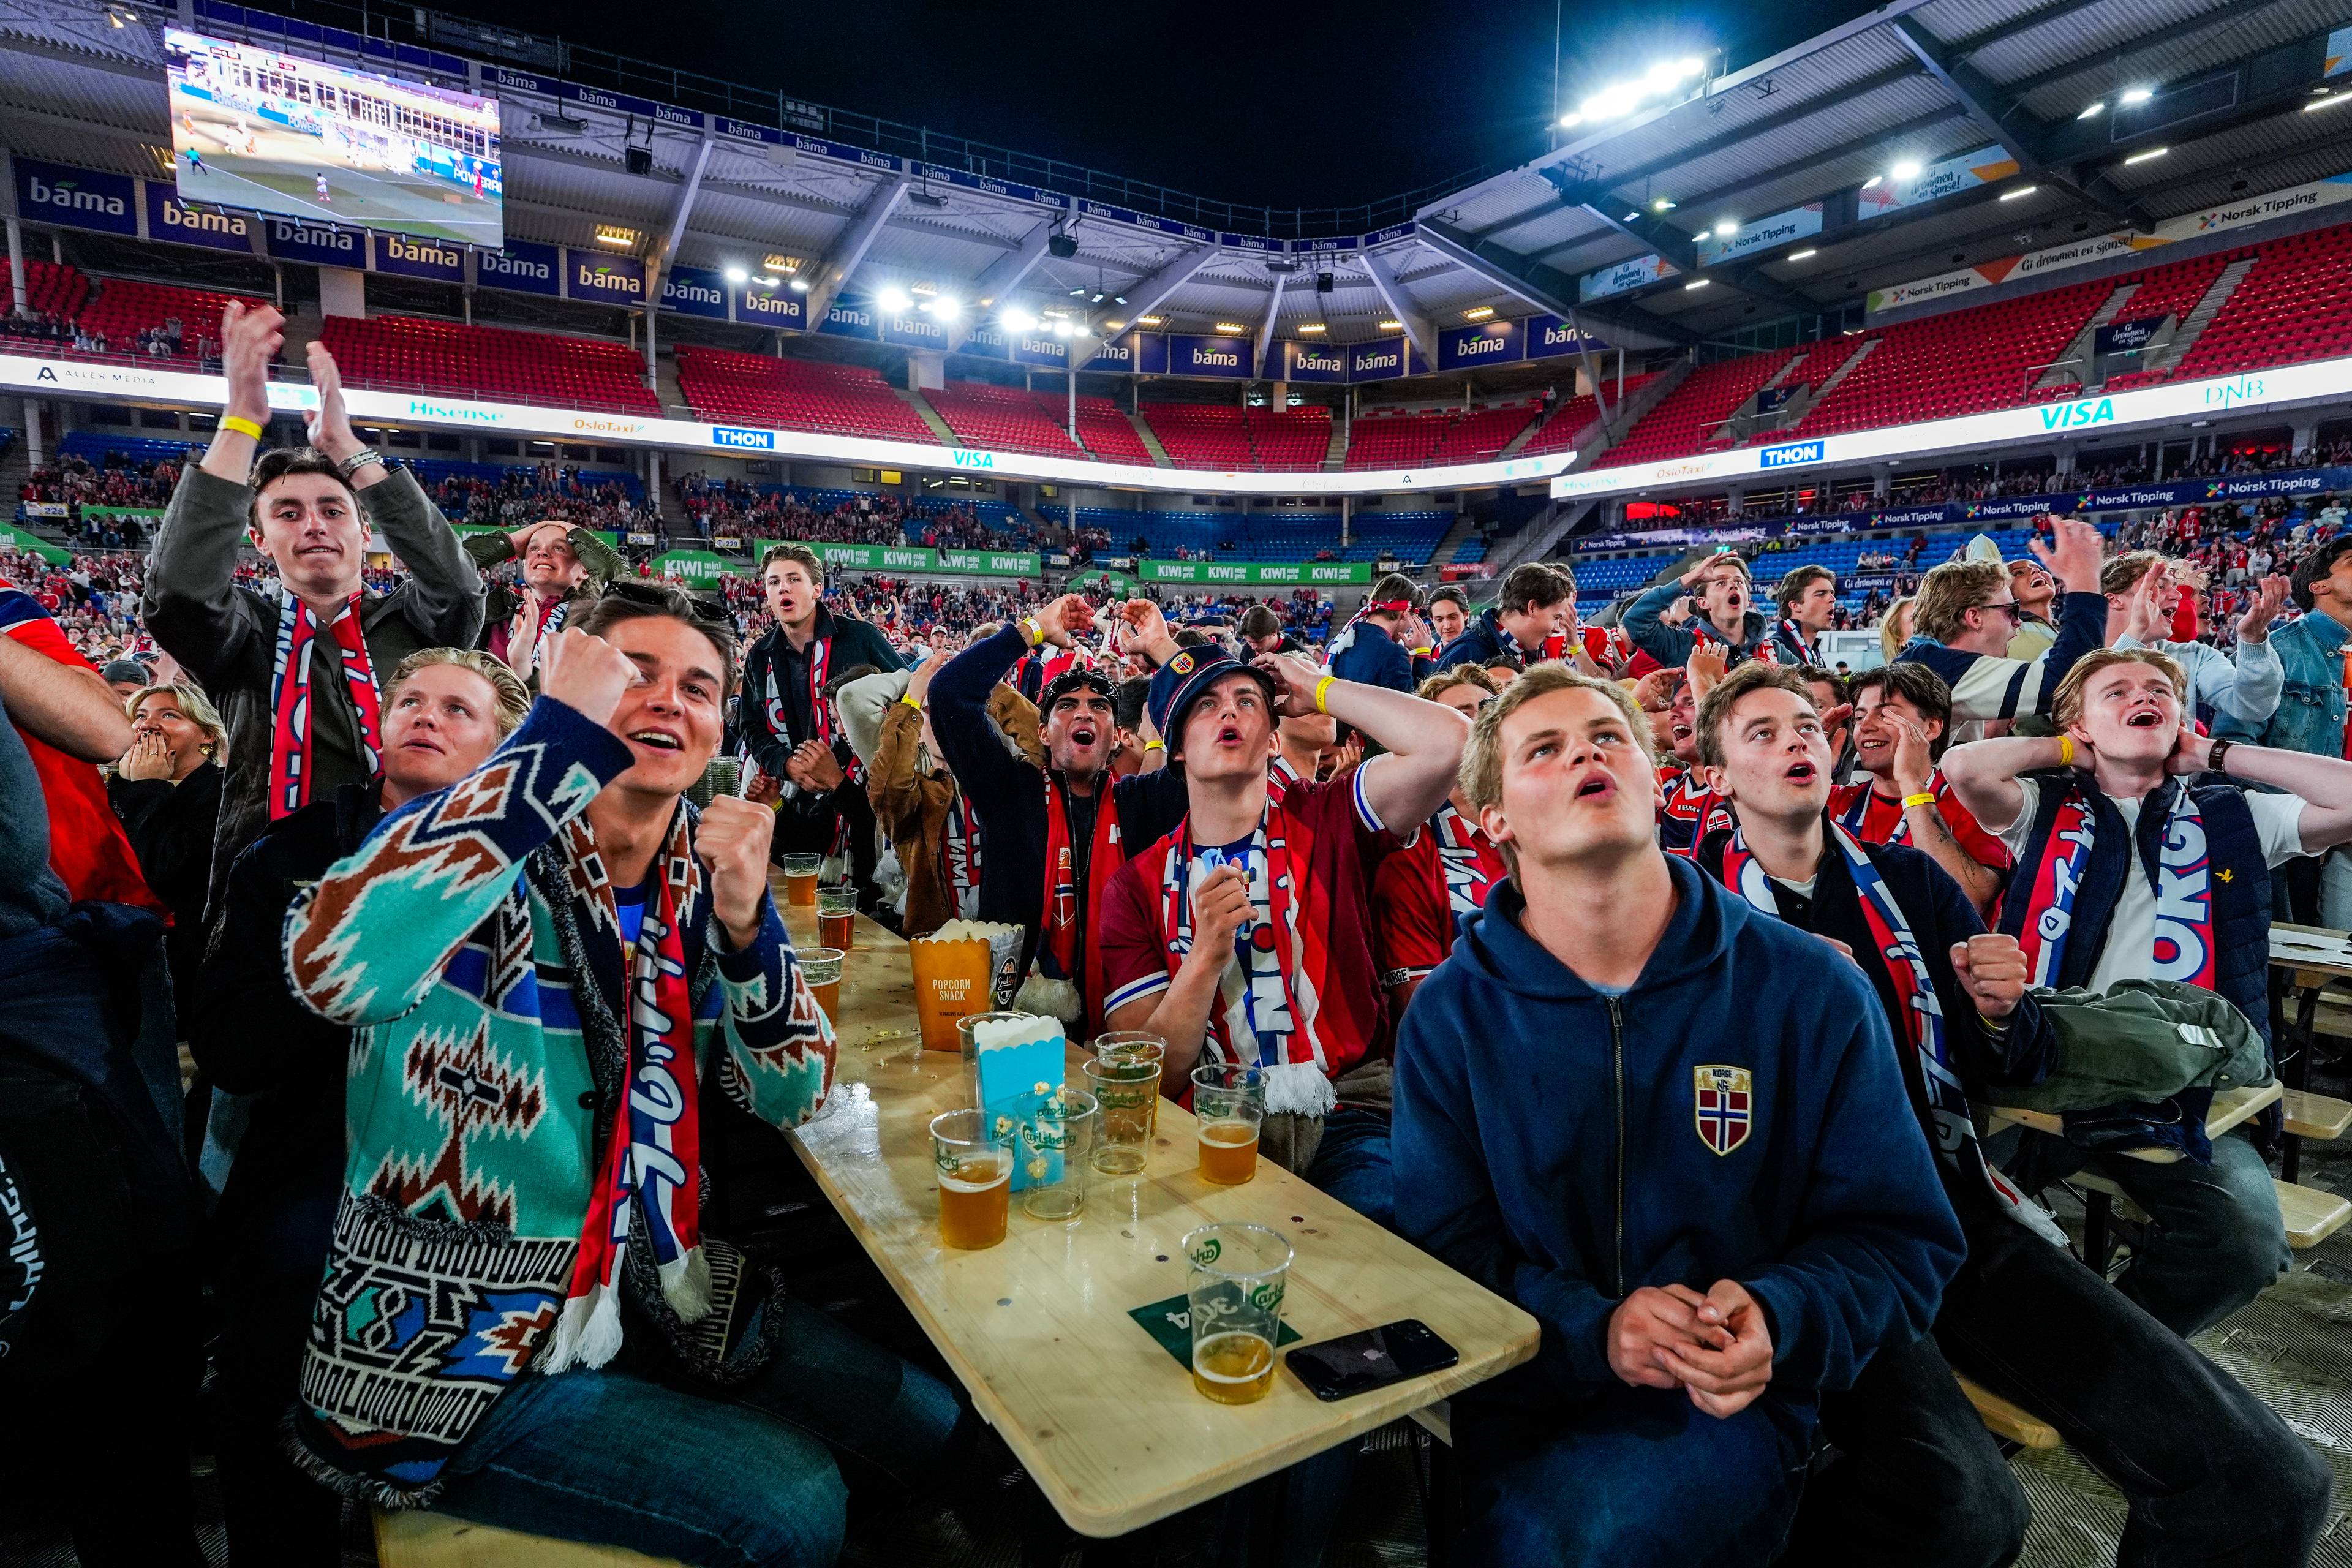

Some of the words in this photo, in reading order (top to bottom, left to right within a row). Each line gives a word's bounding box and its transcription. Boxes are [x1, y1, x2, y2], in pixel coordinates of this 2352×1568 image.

[498, 70, 537, 90] bama
[579, 88, 616, 107] bama
[656, 105, 690, 124] bama
[288, 116, 323, 136] POWERA
[728, 122, 761, 140] bama
[796, 138, 827, 154] bama
[861, 152, 890, 168] bama
[453, 168, 502, 193] POWERA
[31, 177, 124, 216] bama
[1035, 191, 1060, 206] bama
[1087, 203, 1111, 217] bama
[2222, 205, 2261, 223] Norsk
[2264, 192, 2317, 212] Tipping
[164, 201, 246, 235] bama
[1137, 216, 1159, 229] bama
[276, 221, 353, 250] bama
[1184, 227, 1206, 239] bama
[1379, 229, 1401, 241] bama
[1735, 233, 1760, 247] Norsk
[388, 238, 458, 267] bama
[1240, 238, 1264, 249] bama
[1312, 240, 1337, 251] bama
[2022, 259, 2032, 271] Gi
[2037, 248, 2078, 268] drømmen
[2082, 246, 2093, 256] en
[2095, 233, 2134, 255] sjanse!
[482, 251, 549, 279] bama
[579, 266, 640, 292] bama
[1908, 285, 1934, 298] Norsk
[1936, 277, 1970, 292] Tipping
[663, 282, 721, 304] bama
[746, 291, 799, 316] bama
[894, 315, 940, 337] bama
[967, 331, 1001, 346] ama
[1022, 337, 1065, 356] bama
[1457, 337, 1504, 356] bama
[1193, 348, 1237, 366] bama
[1297, 353, 1341, 371] bama
[1355, 353, 1398, 371] bama
[66, 370, 105, 379] ALLER
[113, 375, 156, 385] MEDIA
[2206, 375, 2264, 409] DNB
[410, 401, 505, 421] Hisense
[2040, 399, 2114, 429] VISA
[574, 419, 635, 434] OsloTaxi
[718, 431, 767, 447] THON
[954, 450, 993, 468] VISA
[1766, 446, 1817, 465] THON
[1657, 464, 1705, 480] OsloTaxi
[2229, 481, 2267, 494] Norsk
[2271, 477, 2320, 492] Tipping
[2096, 492, 2128, 505] Norsk
[2132, 491, 2174, 504] Tipping
[1885, 513, 1909, 522] Norsk
[1911, 511, 1943, 522] Tipping
[1983, 504, 2011, 515] Norsk
[2013, 502, 2050, 514] Tipping
[1797, 521, 1820, 530] Norsk
[1822, 519, 1849, 530] Tipping
[825, 548, 854, 563] KIWI
[884, 552, 911, 565] KIWI
[939, 554, 965, 568] KIWI
[992, 556, 1017, 570] KIWI
[665, 560, 702, 578] KIWI
[1158, 565, 1182, 577] KIWI
[1208, 567, 1233, 579] KIWI
[1261, 567, 1286, 579] KIWI
[1312, 567, 1338, 579] KIWI
[2152, 815, 2208, 982] ORG
[933, 979, 971, 990] POPCORN
[1385, 967, 1408, 987] NORGE
[939, 990, 965, 1001] SNACK
[1713, 1069, 1732, 1078] NORGE
[1096, 1087, 1145, 1108] Carlsberg
[1022, 1122, 1077, 1148] Carlsberg
